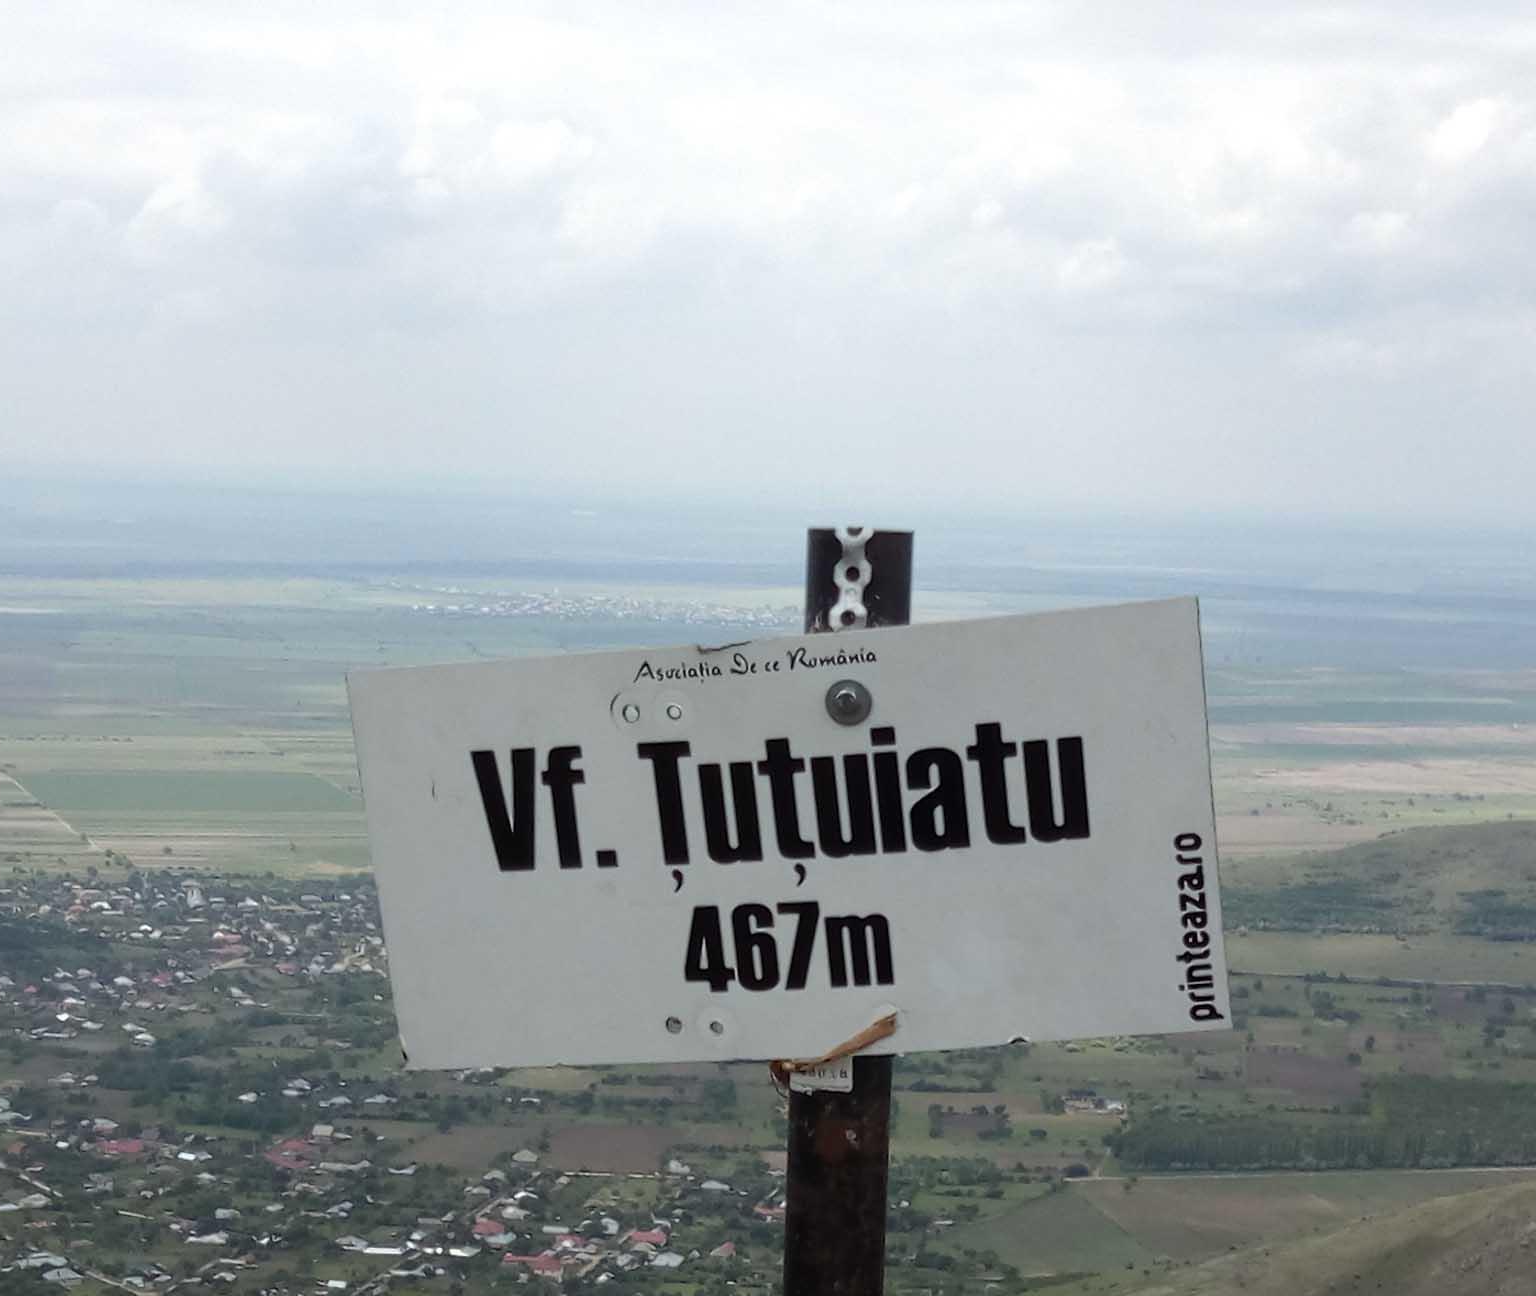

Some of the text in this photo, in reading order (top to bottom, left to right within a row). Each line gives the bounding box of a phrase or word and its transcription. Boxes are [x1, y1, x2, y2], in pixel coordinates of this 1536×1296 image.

[730, 653, 758, 675] De
[764, 660, 781, 672] ce
[787, 647, 877, 670] România
[470, 722, 1091, 894] Vf. Țuțuiatu
[684, 901, 895, 993] 467m
[1174, 832, 1225, 1022] printeaza.ro
